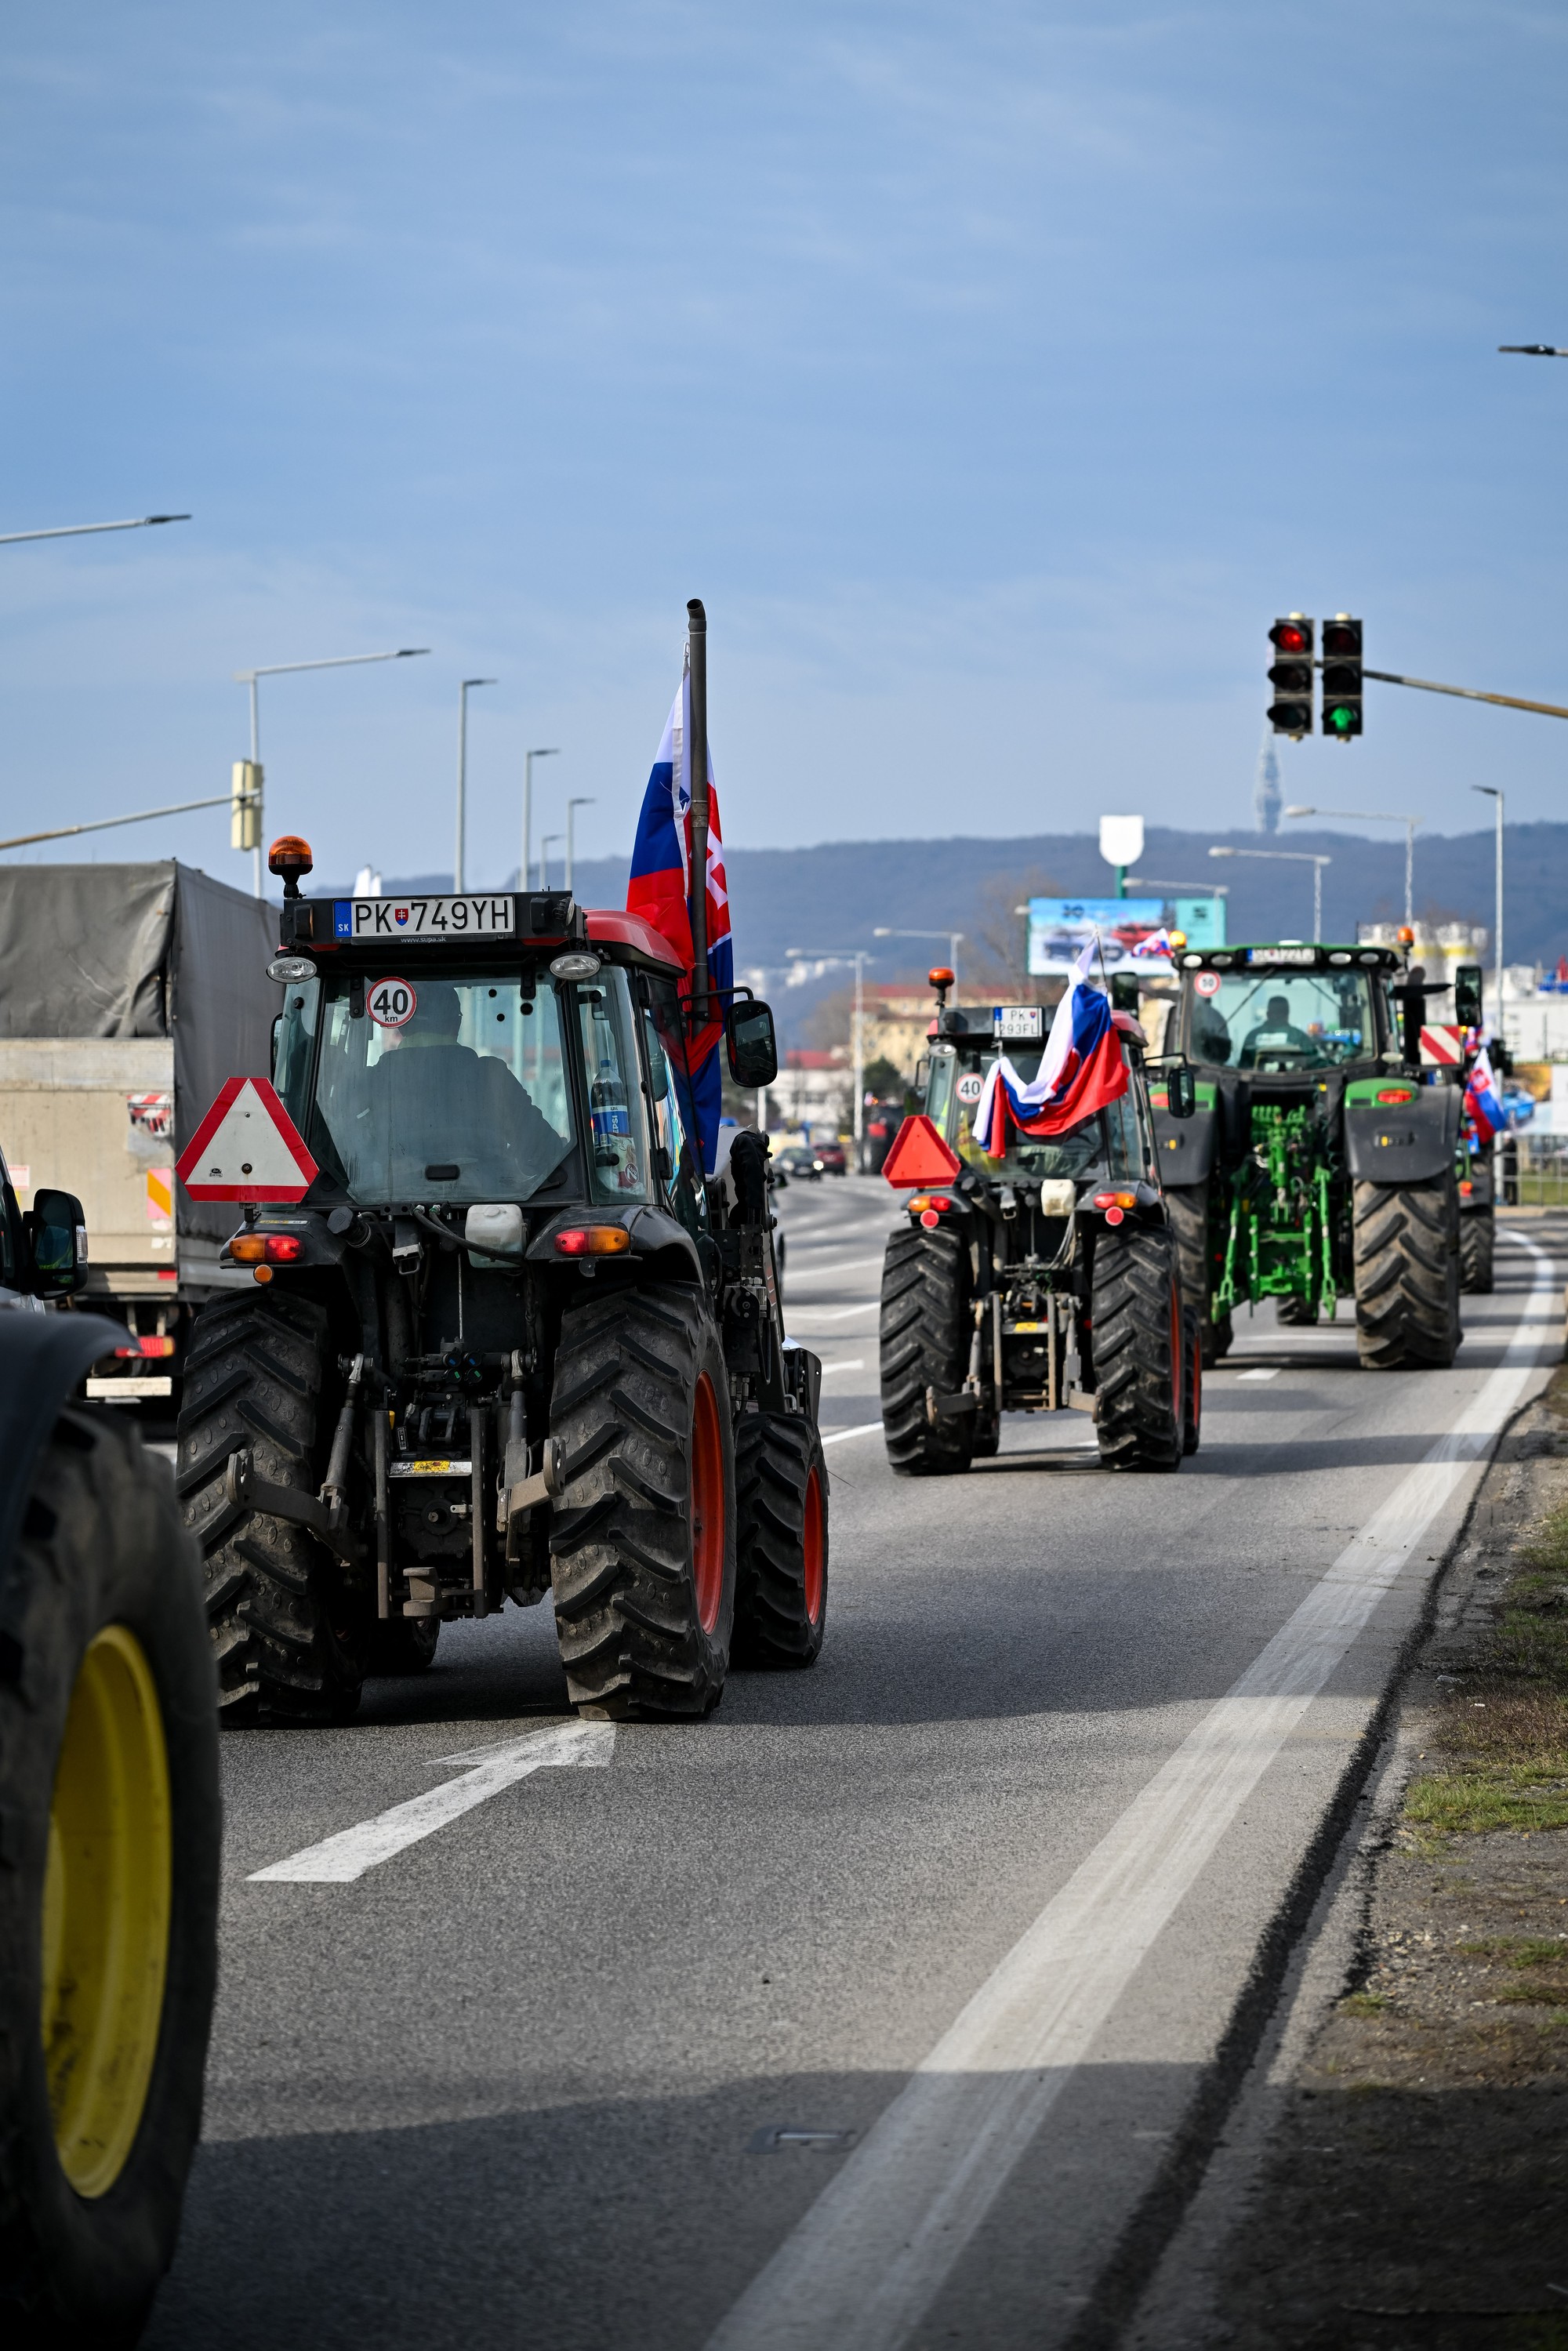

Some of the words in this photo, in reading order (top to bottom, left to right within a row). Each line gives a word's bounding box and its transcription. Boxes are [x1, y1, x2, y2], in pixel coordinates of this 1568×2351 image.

[356, 903, 393, 934] PK
[411, 899, 510, 931] 749YH
[338, 923, 349, 932] SK
[373, 989, 409, 1015] 40
[1011, 1010, 1025, 1021] PK
[1000, 1023, 1038, 1036] 293FL
[960, 1081, 980, 1095] 40
